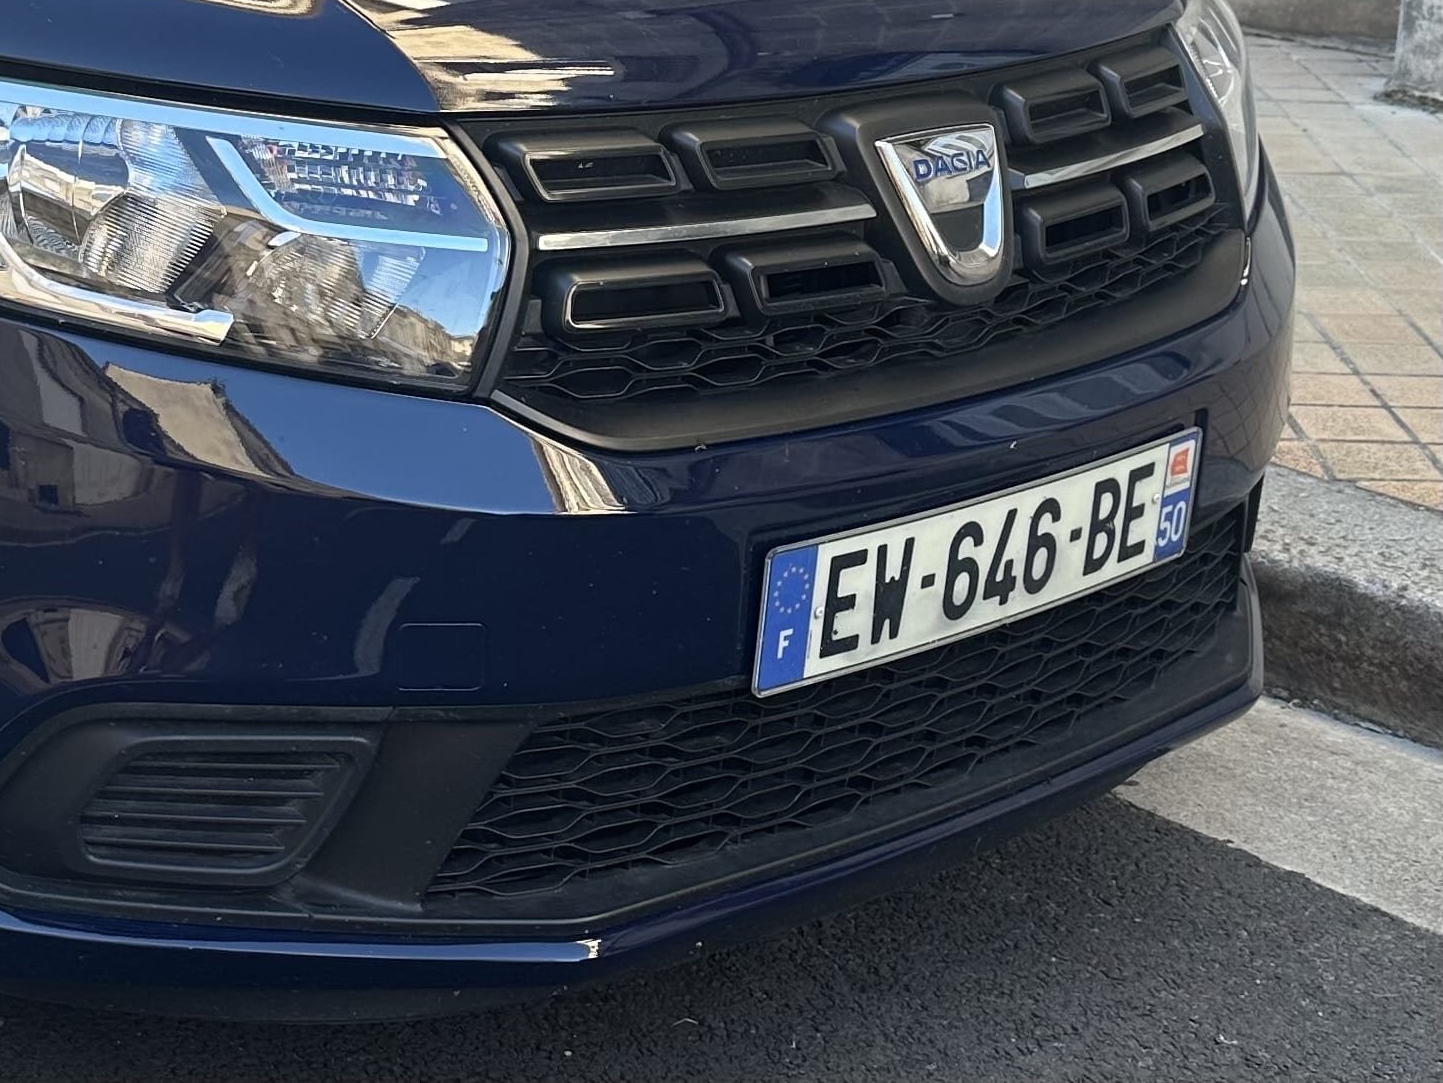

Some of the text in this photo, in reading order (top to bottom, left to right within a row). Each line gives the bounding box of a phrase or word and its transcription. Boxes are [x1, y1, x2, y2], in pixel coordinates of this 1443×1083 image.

[913, 149, 990, 180] DACIA
[777, 462, 1187, 660] F EW-646-BE 50
